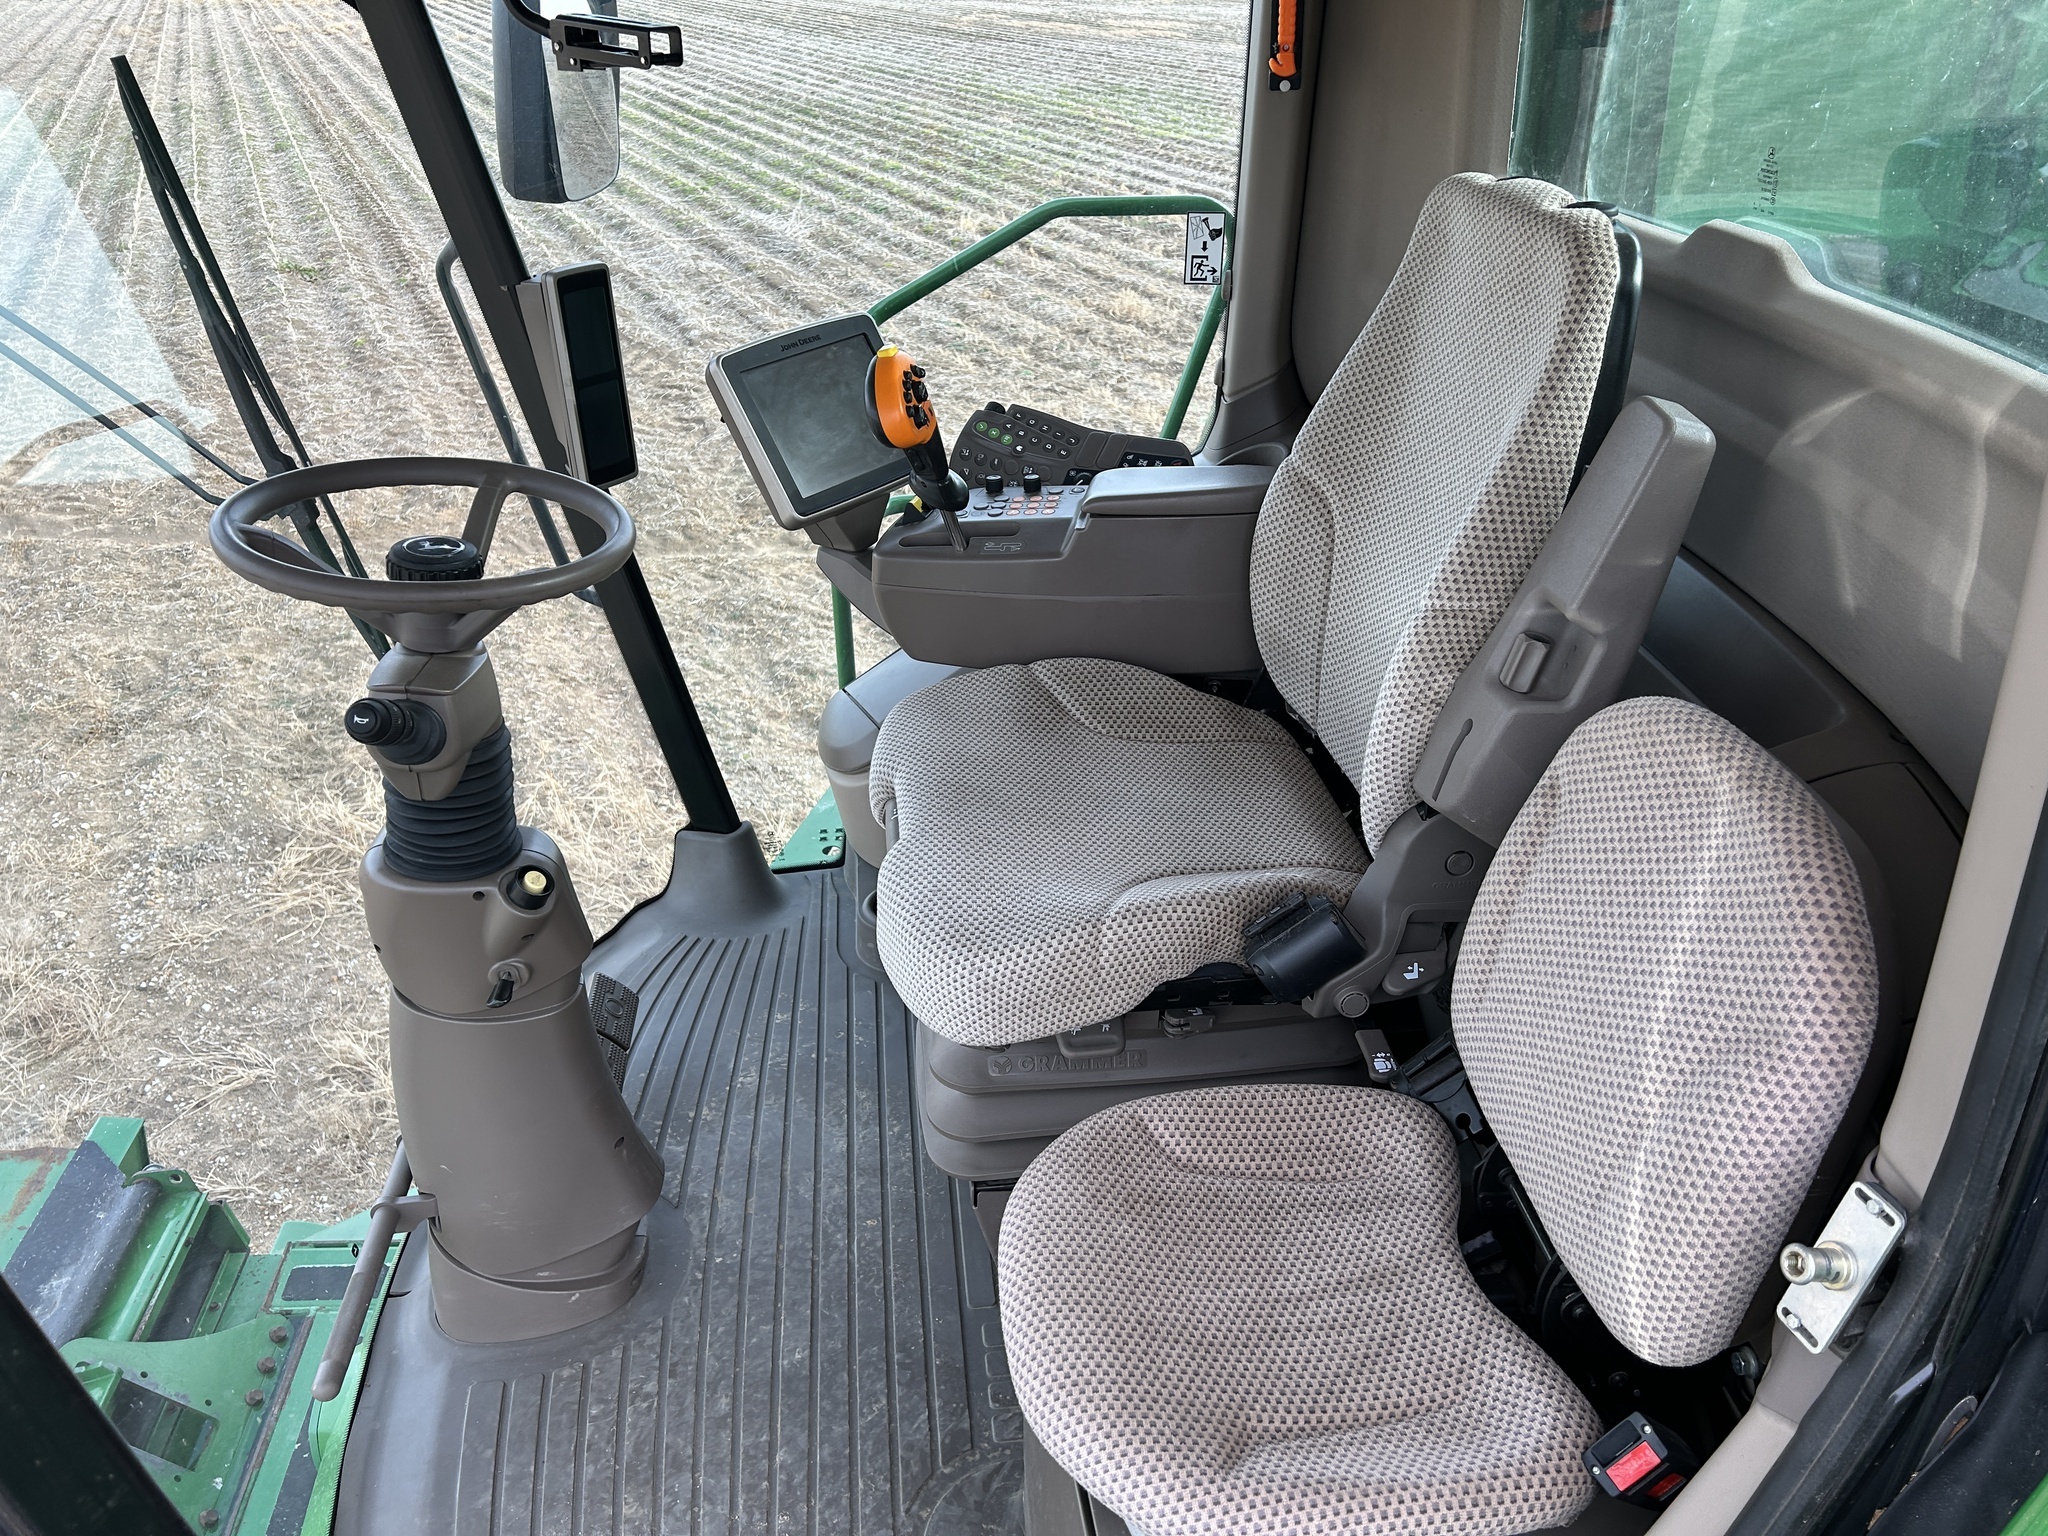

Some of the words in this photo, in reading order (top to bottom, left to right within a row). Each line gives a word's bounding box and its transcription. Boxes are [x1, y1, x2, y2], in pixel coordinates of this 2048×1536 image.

[780, 341, 799, 352] JOHN
[798, 334, 822, 346] DEERE
[1017, 1051, 1143, 1072] GRAMMER
